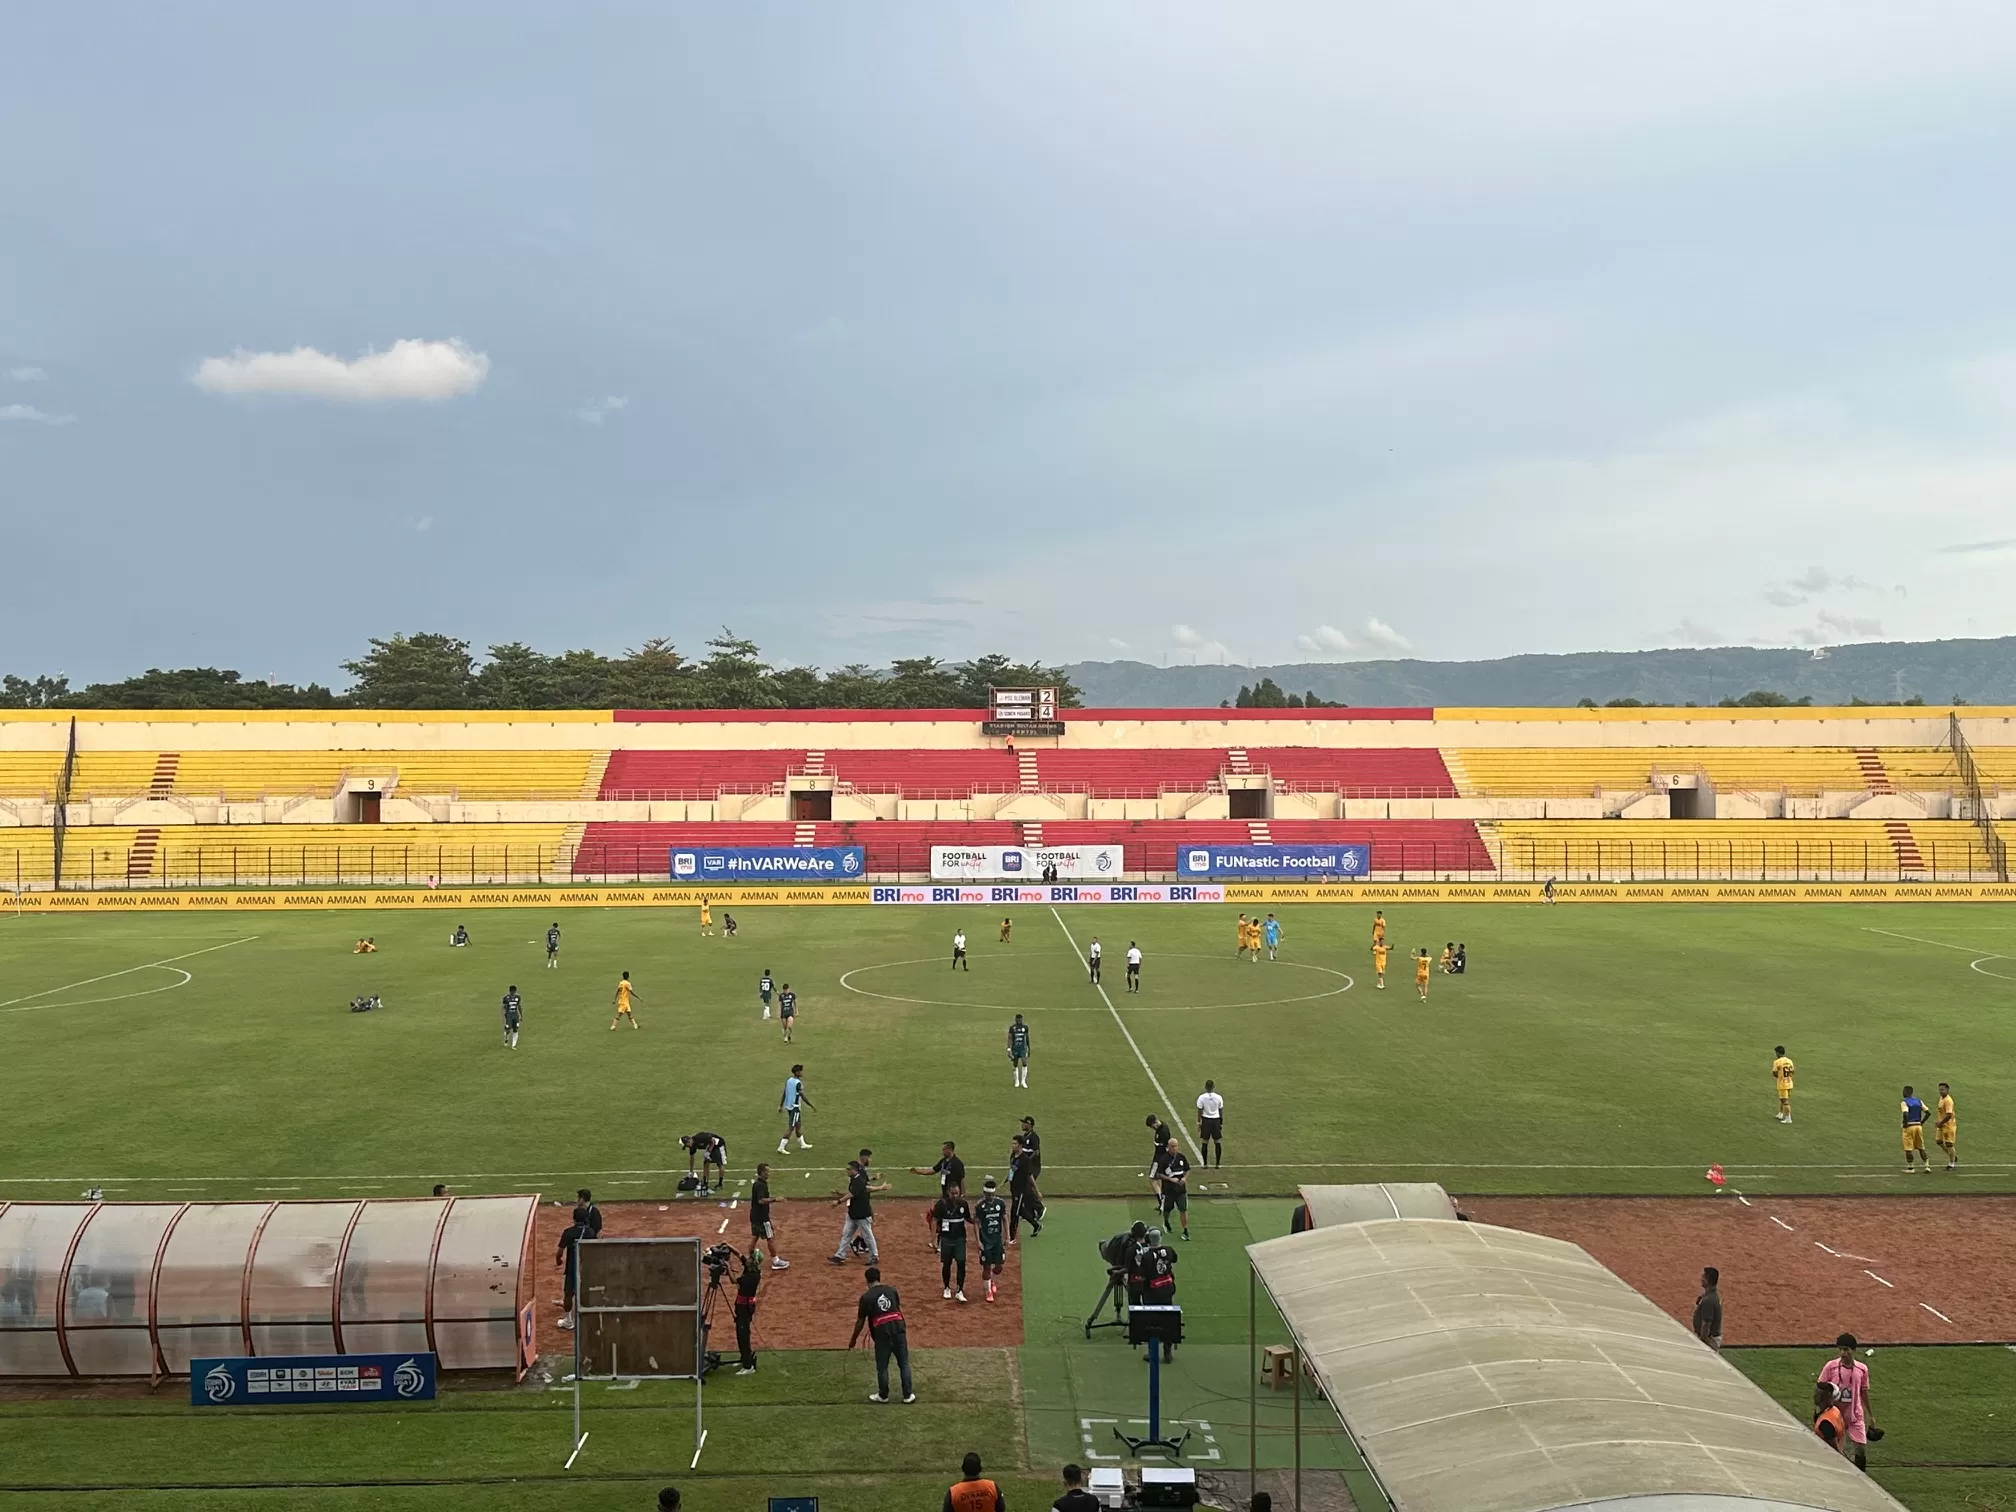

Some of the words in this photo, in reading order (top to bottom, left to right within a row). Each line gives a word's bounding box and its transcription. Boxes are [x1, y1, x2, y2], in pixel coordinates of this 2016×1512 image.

[1044, 691, 1051, 702] 2
[1043, 706, 1051, 717] 4
[368, 780, 374, 790] 9
[810, 780, 815, 790] 8
[1242, 778, 1247, 788] 7
[1673, 775, 1679, 785] 6
[728, 857, 834, 870] #InVARWeAre
[1216, 856, 1279, 868] FUNtastic
[1283, 856, 1336, 868] Football
[874, 889, 924, 902] BRImo
[933, 888, 983, 902] BRImo
[992, 888, 1042, 901] BRImo
[1051, 888, 1101, 901] BRImo
[1110, 887, 1161, 900] BRImo
[1170, 887, 1220, 900] BRImo
[1226, 889, 1262, 898] AMMAN
[1362, 888, 1398, 896] AMMAN
[1402, 888, 1440, 896] AMMAN
[1448, 888, 1486, 896] AMMAN
[1492, 888, 1530, 896] AMMAN
[1539, 888, 1576, 896] AMAN
[1580, 888, 1618, 896] AMMAN
[1626, 888, 1664, 896] AMMAN
[1672, 888, 1708, 896] AMMAN
[1716, 888, 1754, 896] AMMAN
[1758, 888, 1796, 896] AMMAN
[1804, 888, 1842, 896] AMMAN
[1850, 888, 1886, 896] AMMAN
[1894, 888, 1932, 896] AMMAN
[1936, 888, 1972, 896] AMMAN
[2, 898, 42, 906] AMMAN
[50, 897, 88, 906] AMMAN
[98, 897, 136, 906] AMMAN
[140, 896, 180, 906] AMMAN
[188, 896, 228, 904] AMMAN
[236, 896, 276, 904] AMMAN
[284, 896, 324, 904] AMMAN
[326, 895, 366, 904] AMMAN
[374, 895, 414, 904] AMMAN
[422, 894, 462, 902] AMMAN
[470, 894, 508, 902] AMMAN
[512, 894, 550, 902] AMMAN
[560, 893, 598, 902] AMMAN
[652, 892, 690, 900] AMMAN
[786, 891, 824, 900] AMMAN
[832, 891, 870, 900] AMMAN
[971, 1500, 983, 1510] 15
